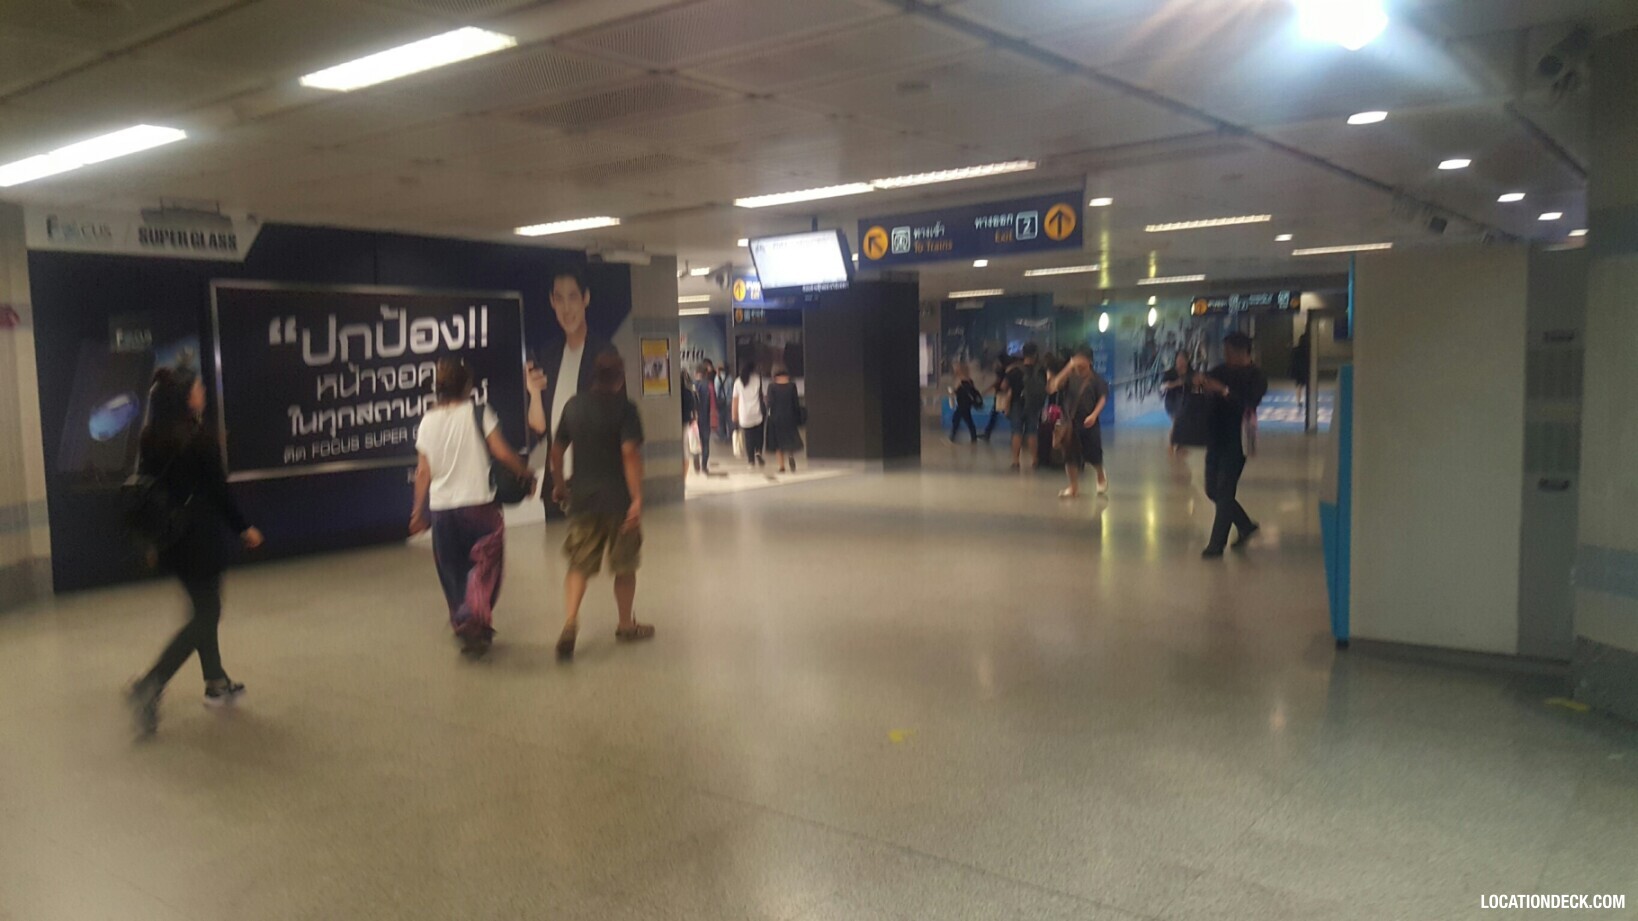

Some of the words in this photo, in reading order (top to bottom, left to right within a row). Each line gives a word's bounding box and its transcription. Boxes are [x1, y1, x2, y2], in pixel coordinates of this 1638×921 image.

[994, 229, 1014, 243] Exit
[914, 240, 926, 254] To
[927, 239, 953, 252] Trains
[311, 434, 360, 459] FOCUS
[365, 426, 408, 450] SUPER
